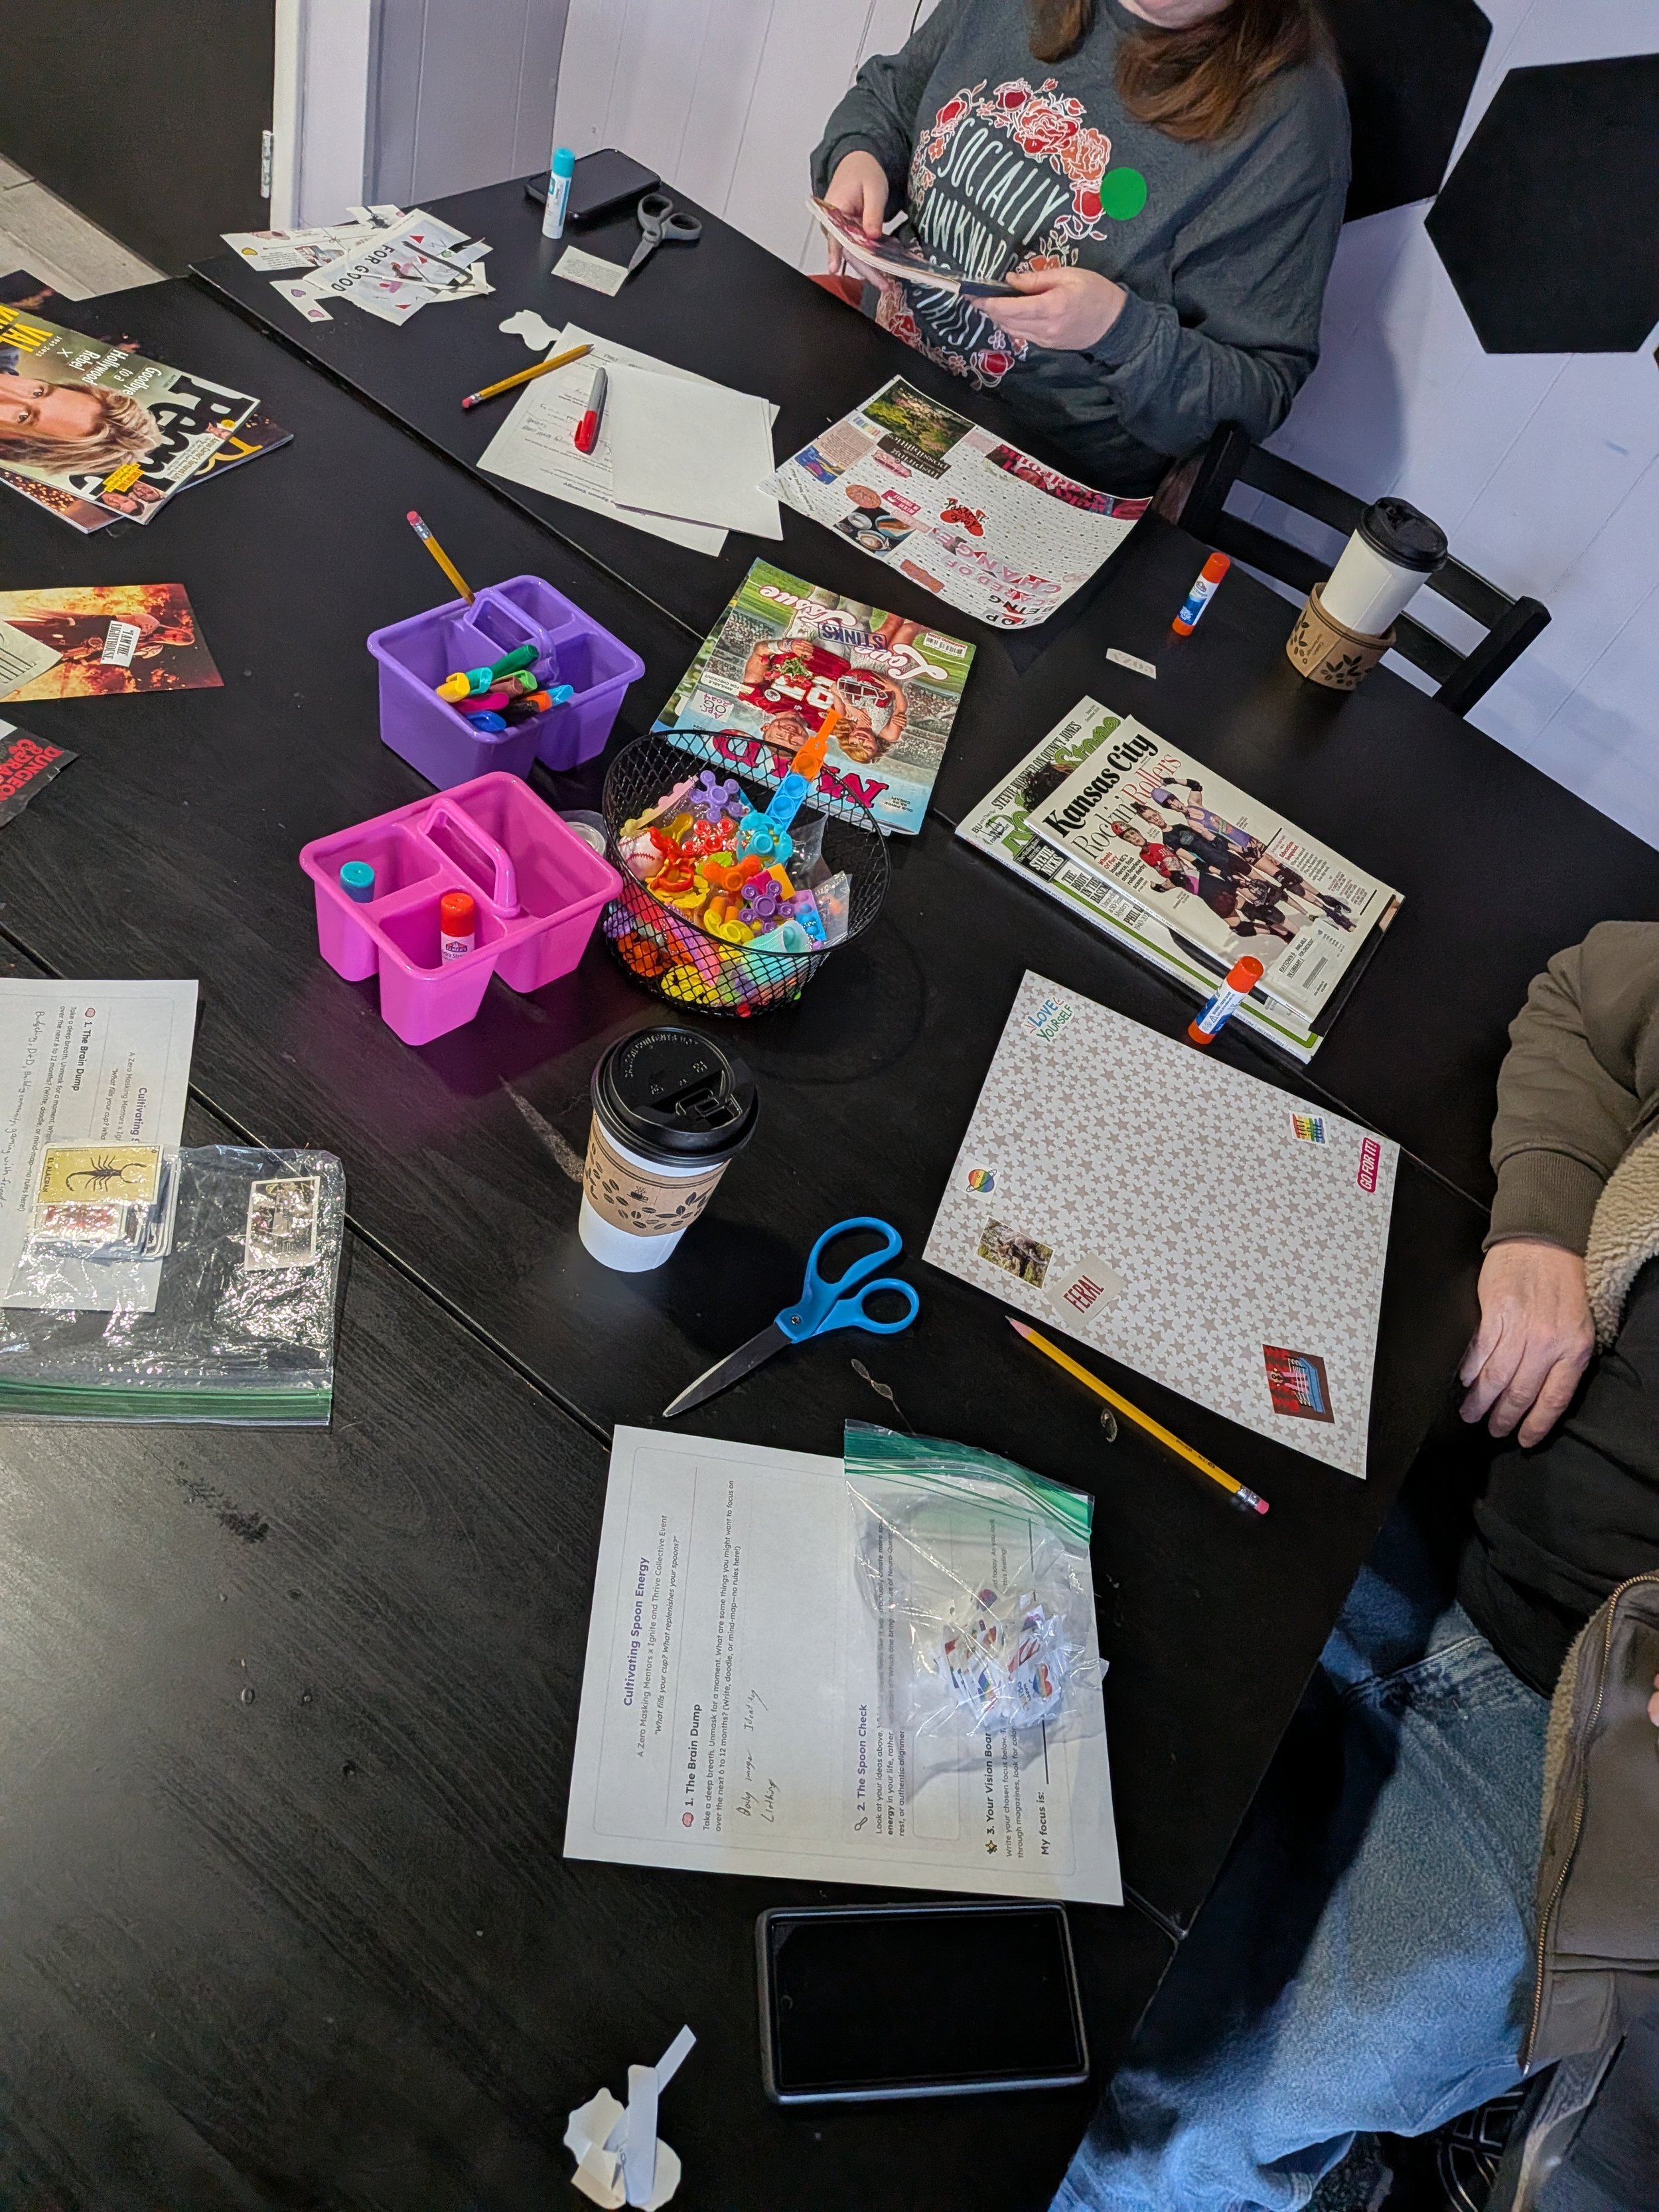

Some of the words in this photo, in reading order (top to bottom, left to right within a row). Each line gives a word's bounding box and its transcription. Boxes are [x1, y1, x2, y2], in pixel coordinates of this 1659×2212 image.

[938, 117, 1068, 244] SOCIALLY
[364, 244, 395, 264] FOR
[331, 265, 369, 291] GOOD
[69, 349, 101, 372] Rebel
[82, 348, 129, 386] Hollywood
[119, 368, 134, 377] to
[123, 366, 162, 396] Goodbye
[887, 433, 950, 469] possibilities
[891, 449, 939, 478] Inspiring
[945, 559, 972, 575] OF
[977, 575, 1058, 606] SCARED
[760, 585, 856, 628] Issue
[988, 595, 1054, 615] BEING
[986, 615, 1043, 626] STOP
[822, 623, 883, 649] STINKS
[704, 674, 729, 685] CHECKOUT
[702, 698, 727, 715] OG
[703, 693, 732, 709] 2024
[0, 747, 64, 802] DUNGEO
[991, 784, 1017, 812] STEVIE
[1040, 735, 1066, 762] QUINCY
[1058, 719, 1082, 743] JONES
[1043, 769, 1119, 837] Kansas
[1108, 733, 1159, 771] City
[1121, 753, 1181, 806] Rollers
[1030, 844, 1054, 871] STEVIE
[1041, 852, 1064, 877] NICKS
[1098, 850, 1112, 866] Wheels
[1108, 854, 1118, 865] Fury
[1109, 859, 1122, 874] Inside
[1118, 852, 1128, 863] KC's
[1115, 863, 1129, 878] fierce,
[1125, 855, 1134, 865] fast
[1121, 871, 1130, 881] and
[1127, 857, 1141, 874] fearless
[1061, 869, 1076, 885] THE
[1071, 872, 1089, 891] BODY
[1085, 876, 1101, 892] THE
[1126, 873, 1137, 885] roller
[1134, 862, 1147, 876] derby
[1131, 875, 1144, 889] scene
[1080, 887, 1092, 898] IN
[1090, 881, 1112, 904] BASEM
[1278, 954, 1294, 972] RAYTOWN
[1289, 959, 1301, 974] LIBRARY
[1028, 999, 1058, 1027] LOVE
[1037, 1004, 1073, 1041] YOURSELF
[80, 1029, 91, 1044] The
[77, 1046, 88, 1067] Brain
[71, 1068, 84, 1090] Dump
[130, 1087, 147, 1135] Cultivating
[1, 1128, 17, 1153] gaming
[1363, 1140, 1378, 1155] IT!
[1, 1156, 15, 1176] with
[1360, 1153, 1376, 1175] FOR
[42, 1166, 52, 1192] ALACRAN
[1358, 1173, 1373, 1189] GO
[1063, 1275, 1104, 1313] FERAL
[729, 1480, 734, 1489] on
[658, 1514, 667, 1536] Event
[654, 1538, 665, 1576] Collective
[723, 1536, 731, 1558] might
[634, 1556, 649, 1597] Energy
[669, 1570, 678, 1587] your
[720, 1574, 729, 1597] things
[652, 1577, 661, 1601] Thrive
[630, 1599, 644, 1637] Spoon
[664, 1588, 675, 1630] replenishes
[647, 1621, 657, 1646] Ignite
[662, 1632, 670, 1653] What
[623, 1640, 640, 1706] Cultivating
[643, 1655, 653, 1689] Mentors
[660, 1655, 669, 1673] cup?
[713, 1657, 721, 1692] moment.
[640, 1691, 650, 1726] Masking
[690, 1704, 702, 1736] Dump
[709, 1714, 717, 1746] Unmask
[858, 1704, 867, 1737] Check
[638, 1728, 646, 1748] Zero
[687, 1739, 697, 1769] Brain
[706, 1748, 715, 1777] breath.
[857, 1739, 867, 1775] Spoon
[685, 1772, 695, 1793] The
[985, 1760, 993, 1793] Vision
[685, 1797, 693, 1806] 1.
[705, 1779, 713, 1801] deep
[857, 1801, 865, 1810] 2.
[987, 1825, 994, 1834] 3.
[1038, 1806, 1047, 1835] focus
[1040, 1838, 1050, 1855] My
